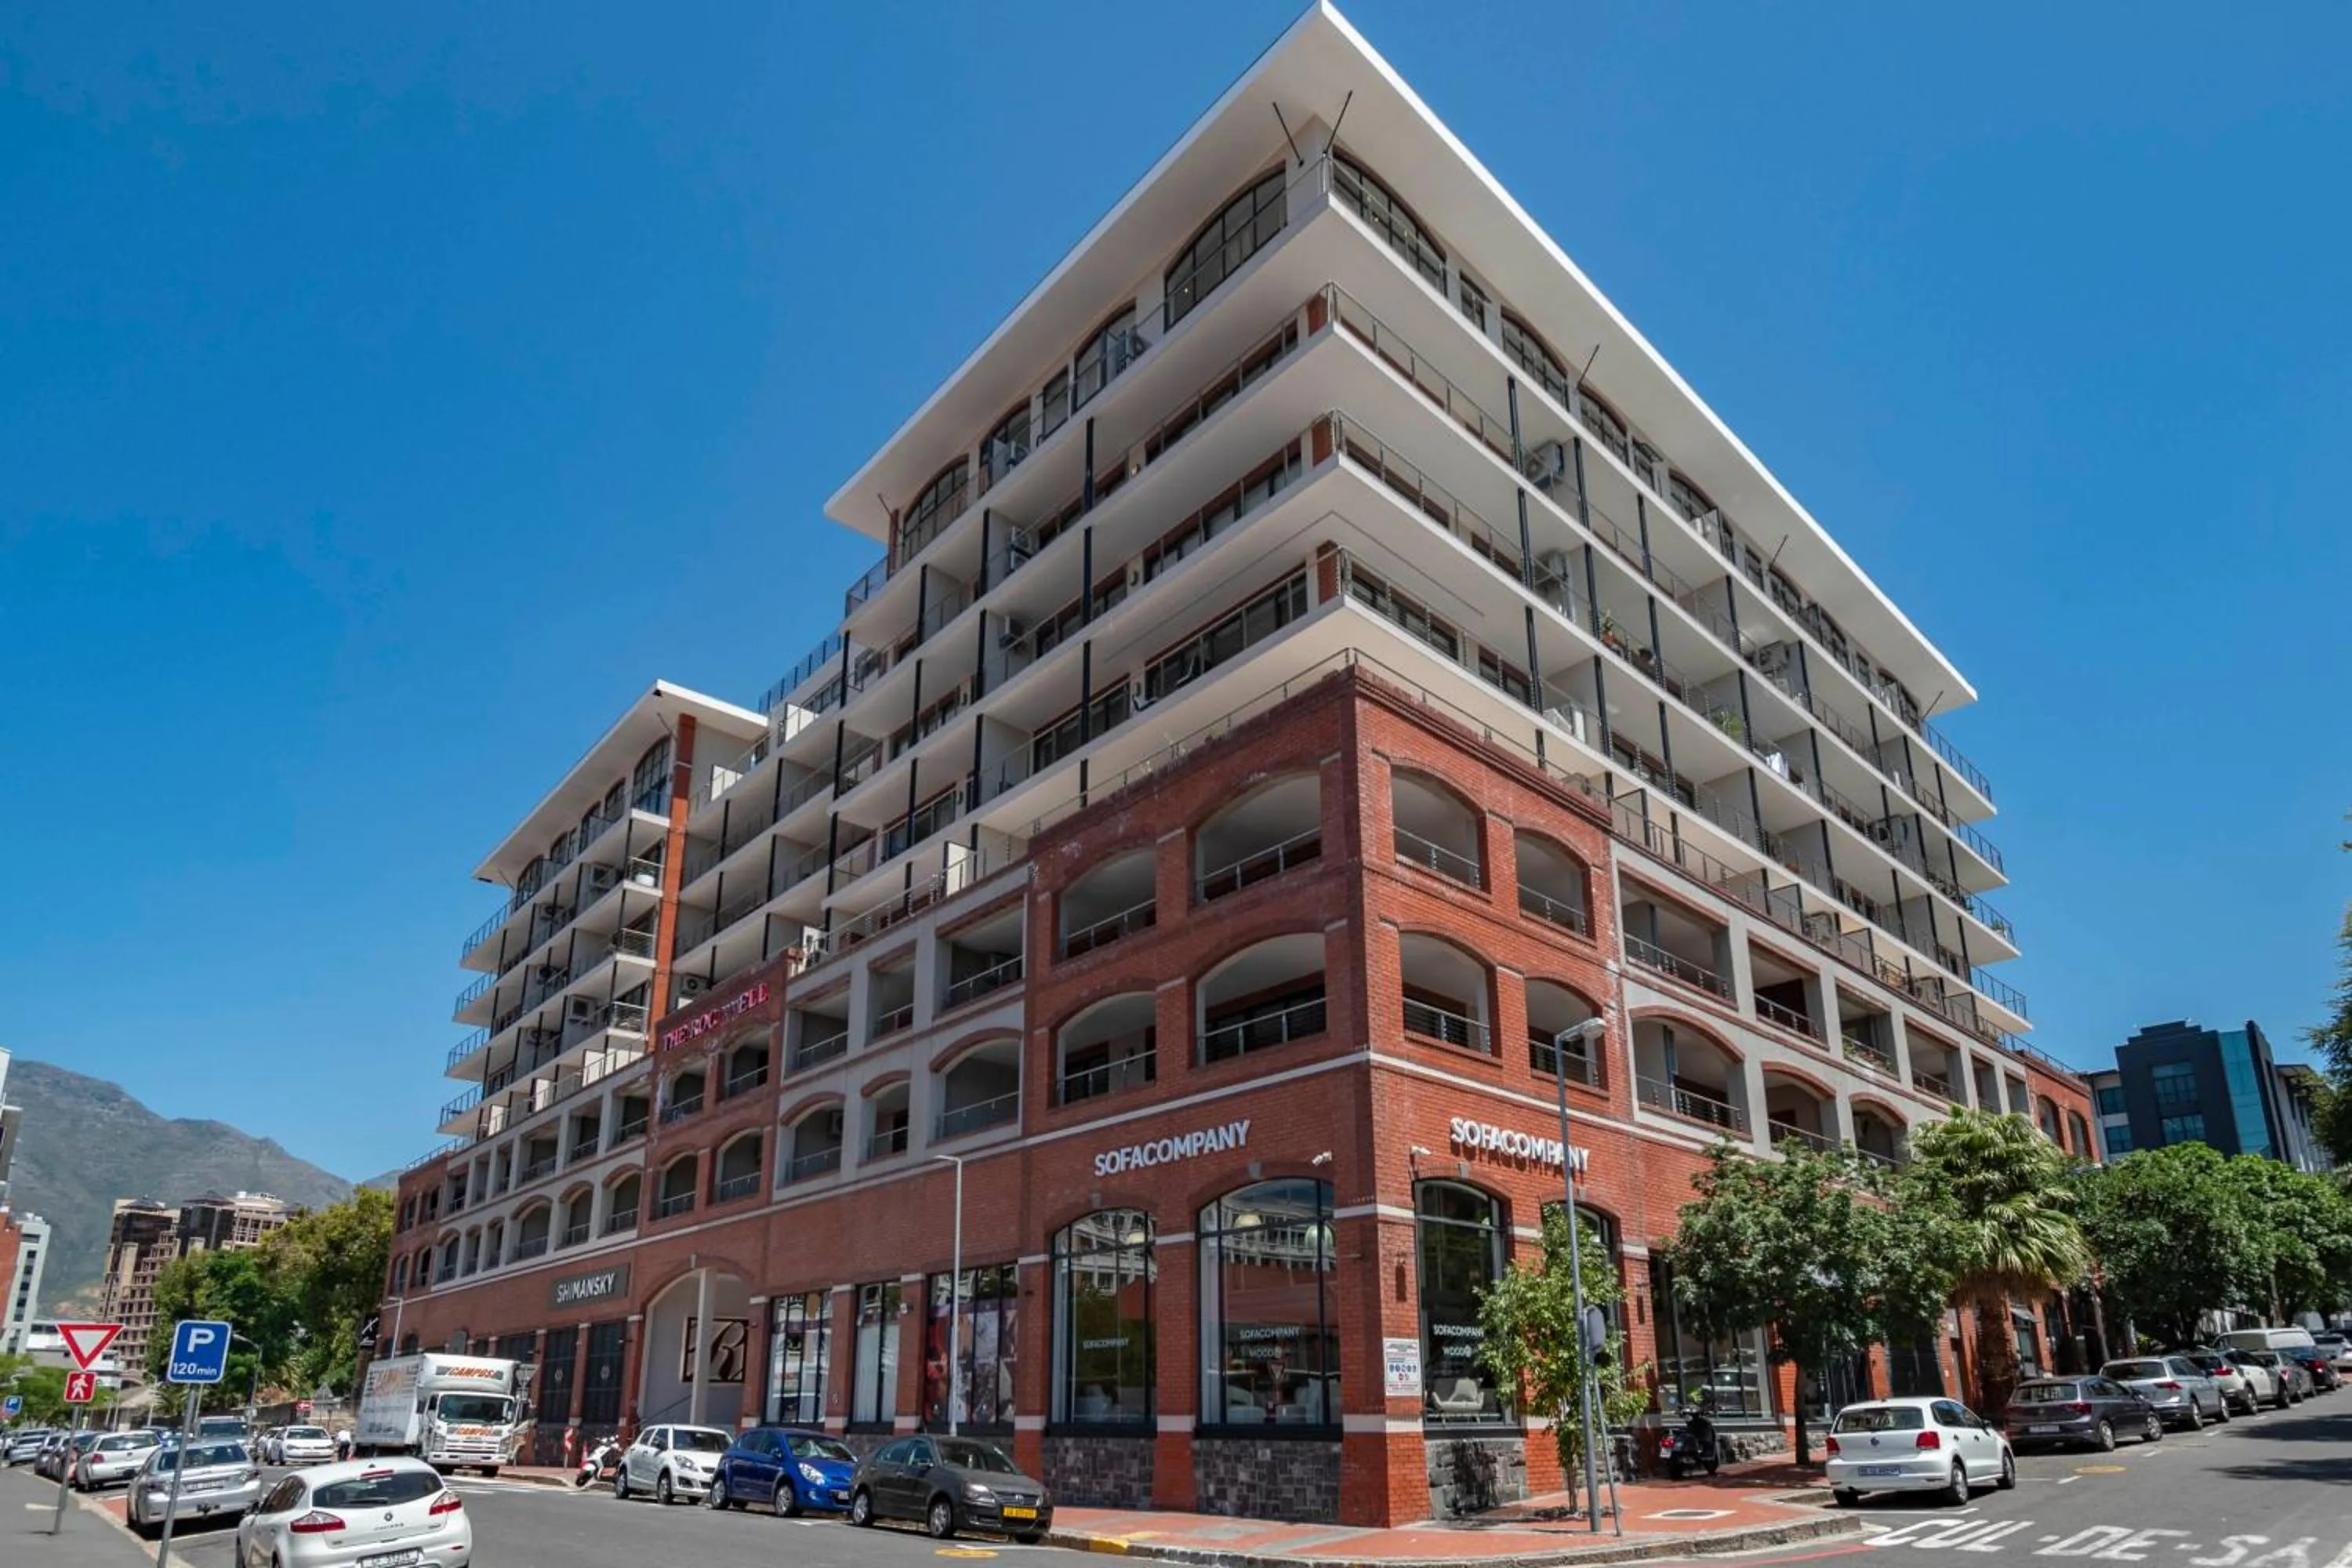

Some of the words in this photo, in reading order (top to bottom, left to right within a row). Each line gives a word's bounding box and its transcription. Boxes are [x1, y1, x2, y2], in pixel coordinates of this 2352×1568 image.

[663, 1024, 690, 1051] THE
[1094, 1120, 1251, 1177] SOFACOMPANY
[1450, 1117, 1590, 1171] SOFACOMPANY
[557, 1272, 615, 1303] SHIMANSKY
[187, 1328, 216, 1352] P
[1433, 1324, 1484, 1338] SOFACOMPAN
